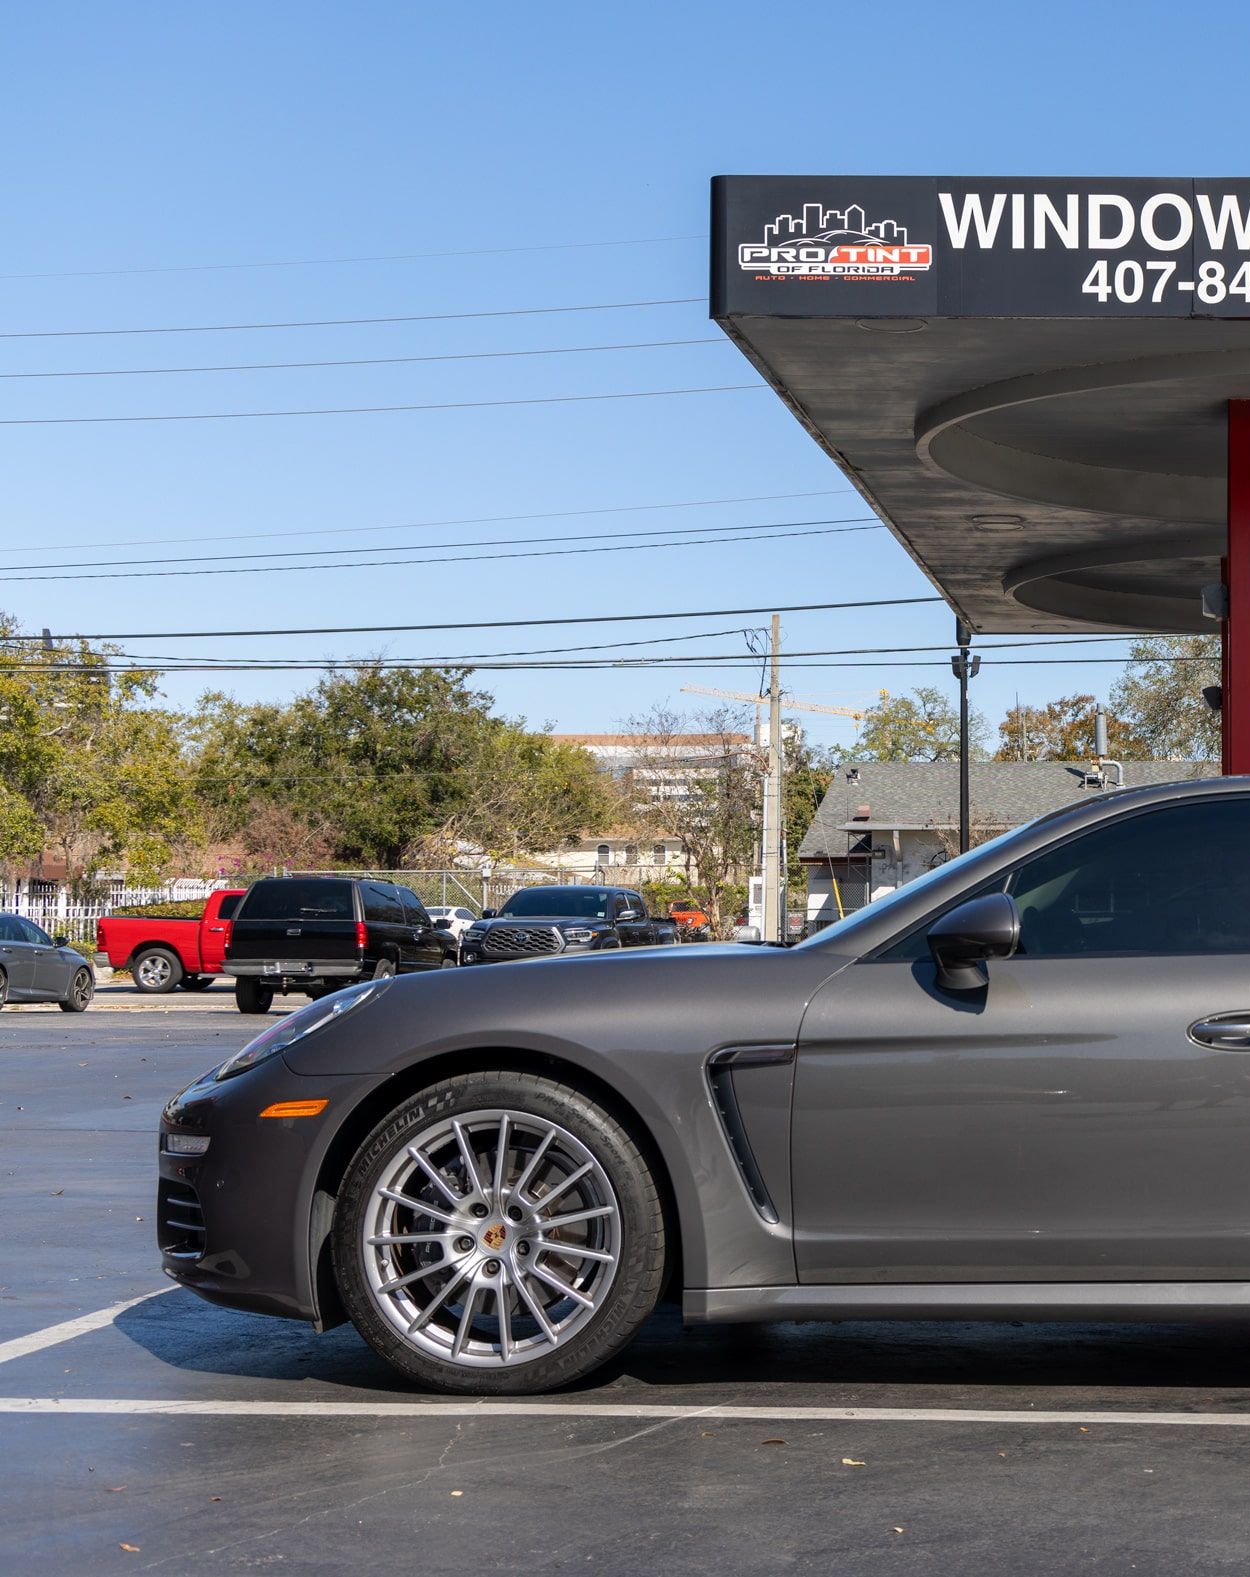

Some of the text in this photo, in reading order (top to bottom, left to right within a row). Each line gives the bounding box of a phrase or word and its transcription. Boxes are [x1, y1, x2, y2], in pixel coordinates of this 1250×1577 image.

[743, 247, 928, 263] PRO TINT
[776, 265, 894, 274] OF FLORIDA
[359, 1105, 421, 1176] MICHELIN
